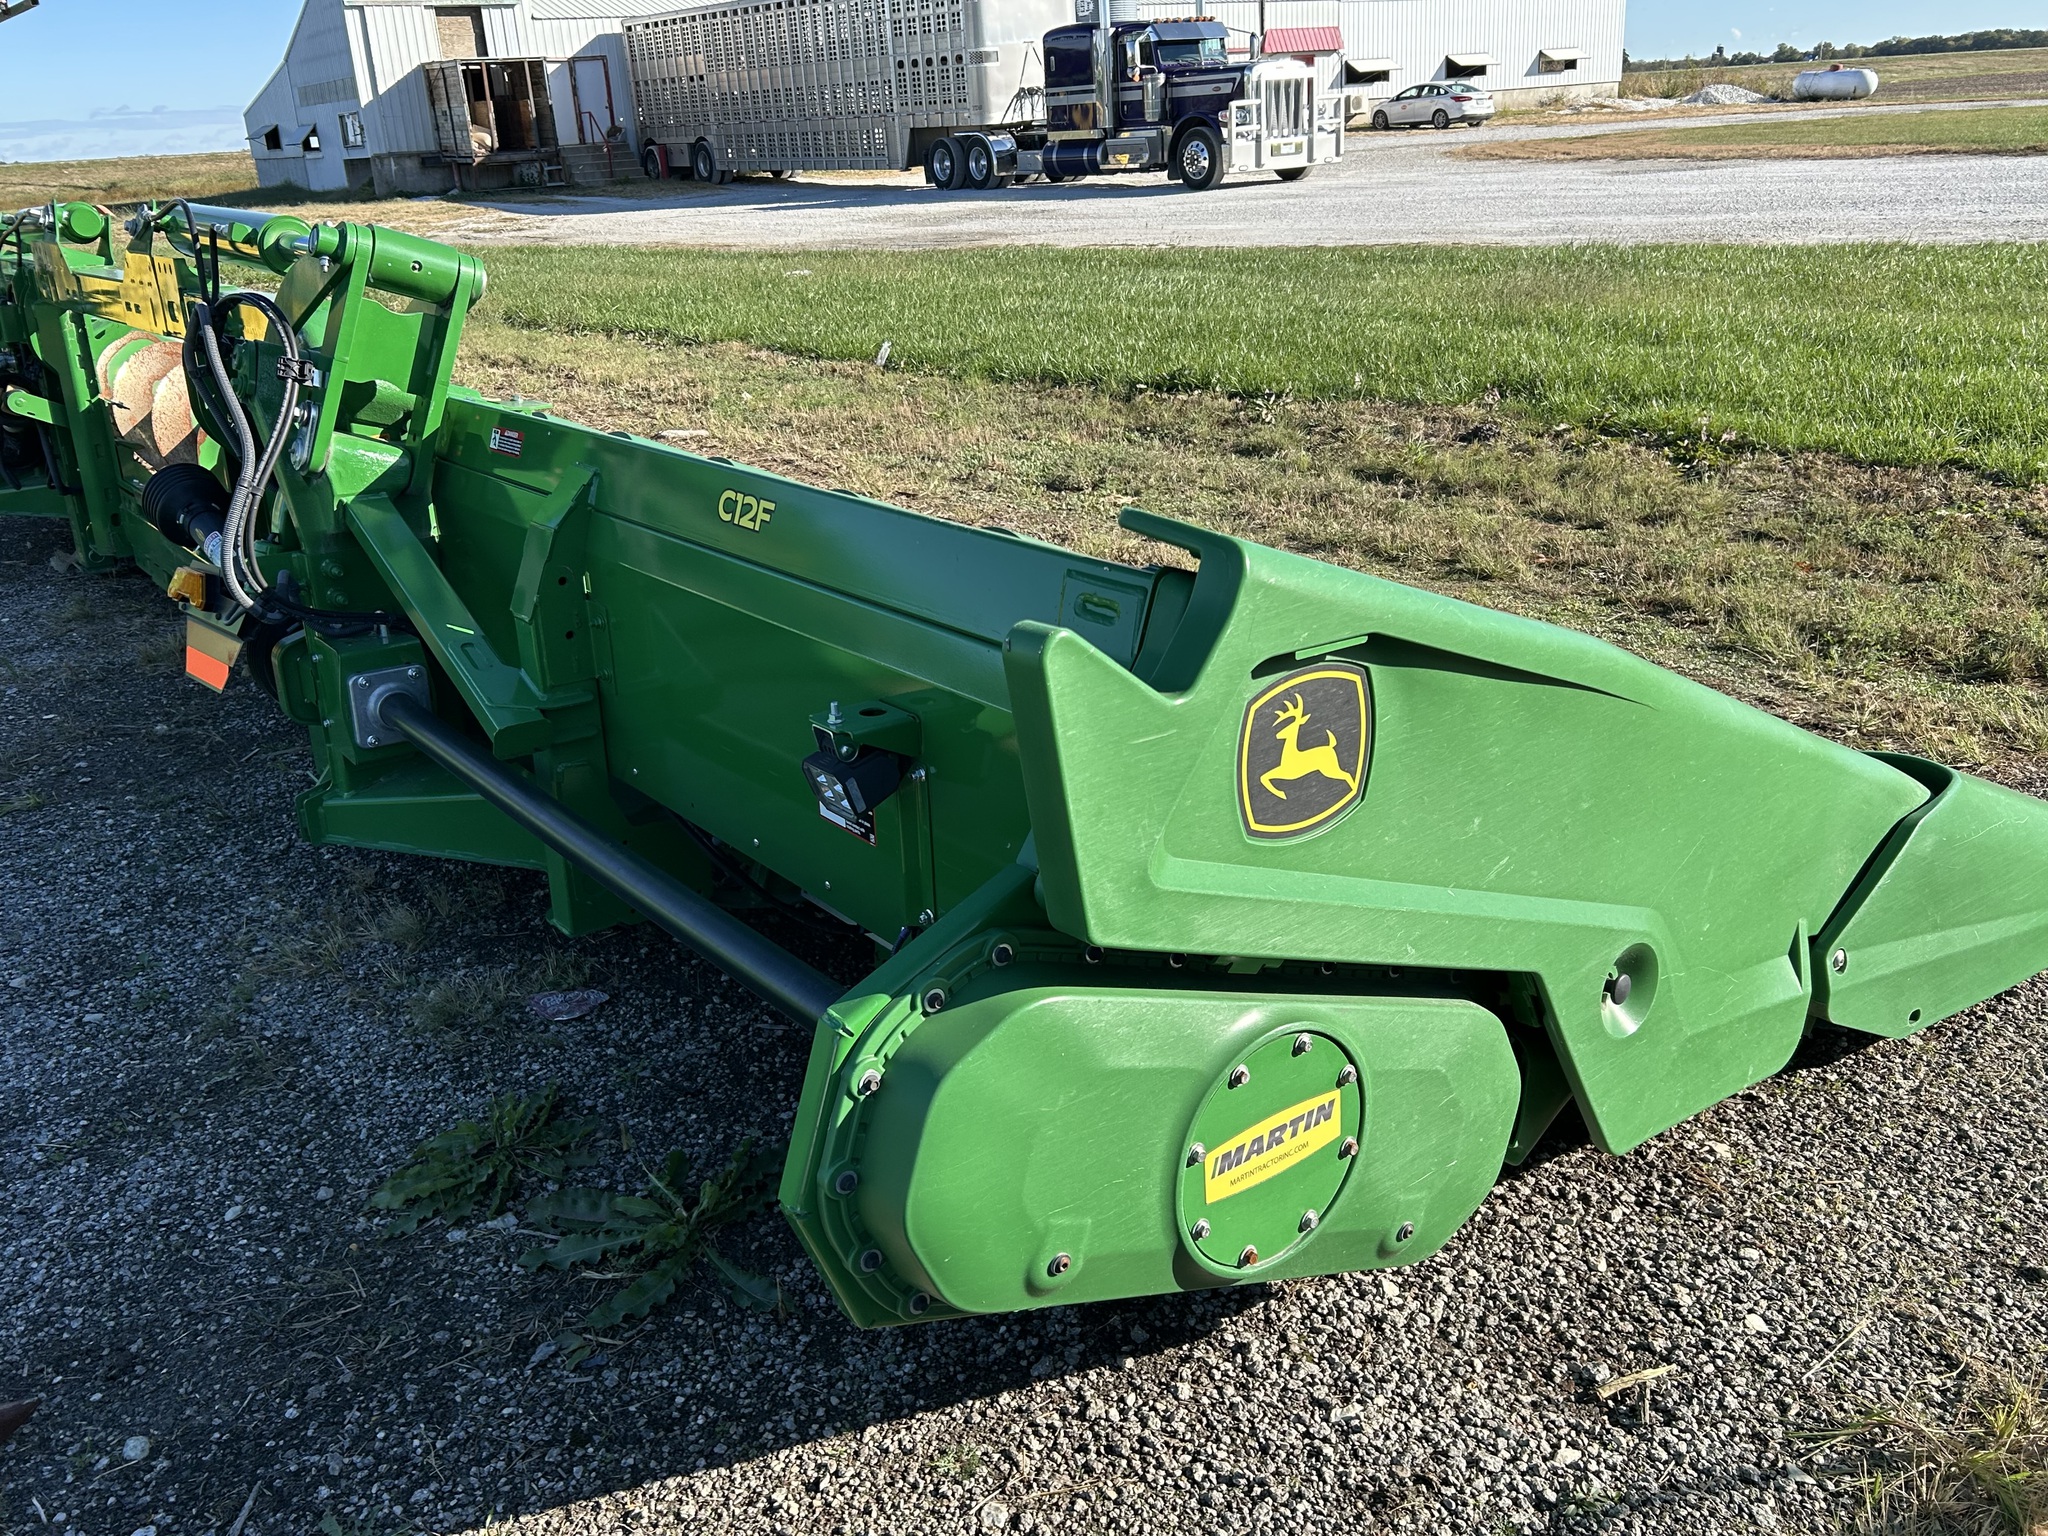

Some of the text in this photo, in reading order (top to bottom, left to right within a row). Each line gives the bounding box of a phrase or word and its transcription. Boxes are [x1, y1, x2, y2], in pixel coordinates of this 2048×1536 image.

[718, 488, 777, 532] C12F
[1212, 1097, 1336, 1179] MARTIN
[1229, 1140, 1310, 1187] MARTINTRACTORINC.COM
